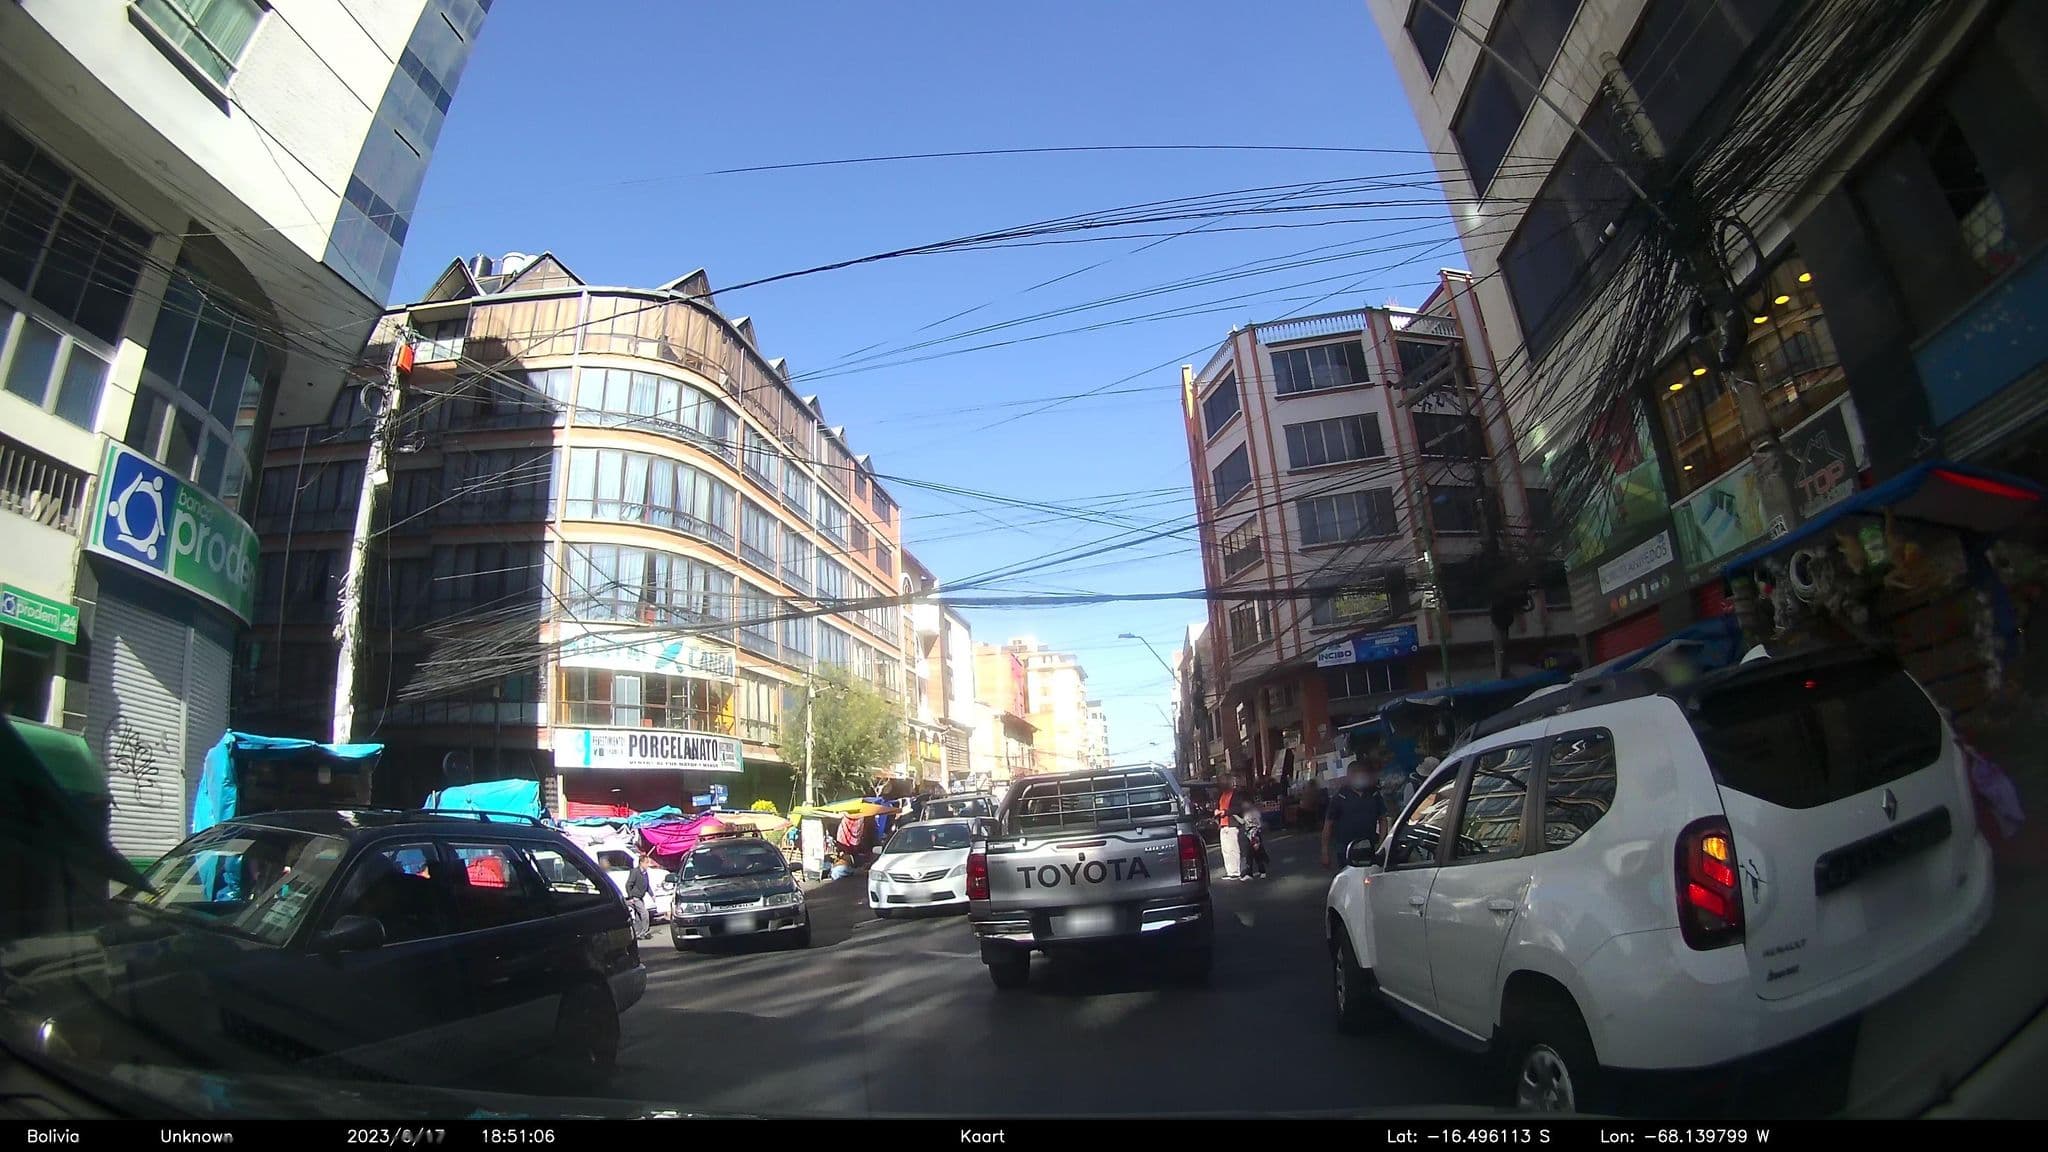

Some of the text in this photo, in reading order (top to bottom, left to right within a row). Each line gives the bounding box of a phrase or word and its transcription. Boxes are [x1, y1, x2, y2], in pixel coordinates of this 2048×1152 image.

[1799, 460, 1845, 503] TOP
[168, 508, 257, 591] prode
[16, 602, 78, 629] prodem 24
[1317, 649, 1352, 662] INCIBO
[628, 734, 719, 761] PORCELANATO
[1016, 856, 1151, 889] TOYOTA
